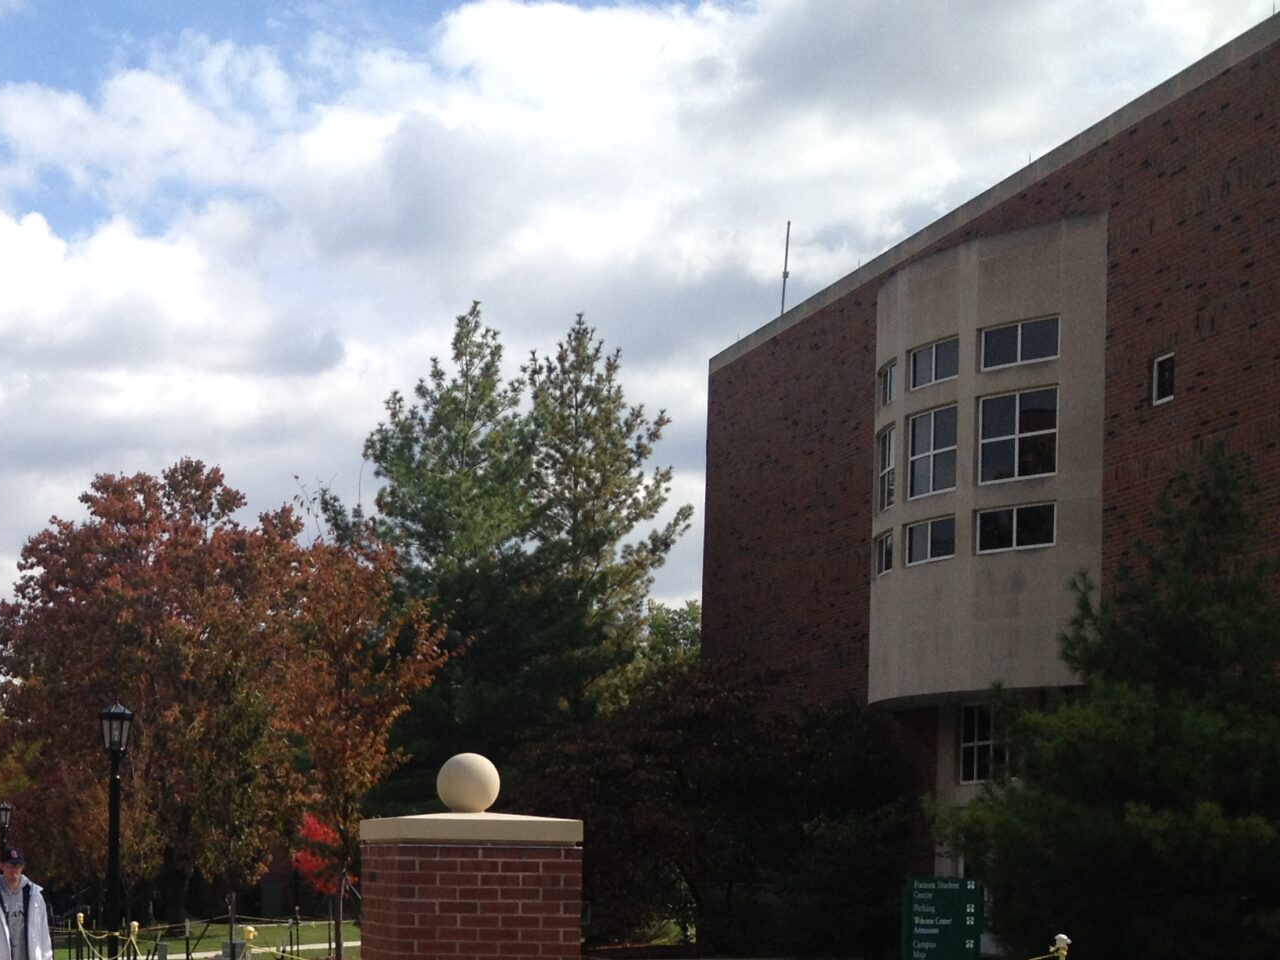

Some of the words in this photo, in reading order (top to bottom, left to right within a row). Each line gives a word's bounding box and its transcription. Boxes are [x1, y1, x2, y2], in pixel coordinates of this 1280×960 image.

[913, 891, 932, 899] Center
[913, 903, 936, 913] Parking
[913, 916, 935, 925] Welcome
[913, 940, 936, 950] Campus
[913, 950, 927, 960] Map
